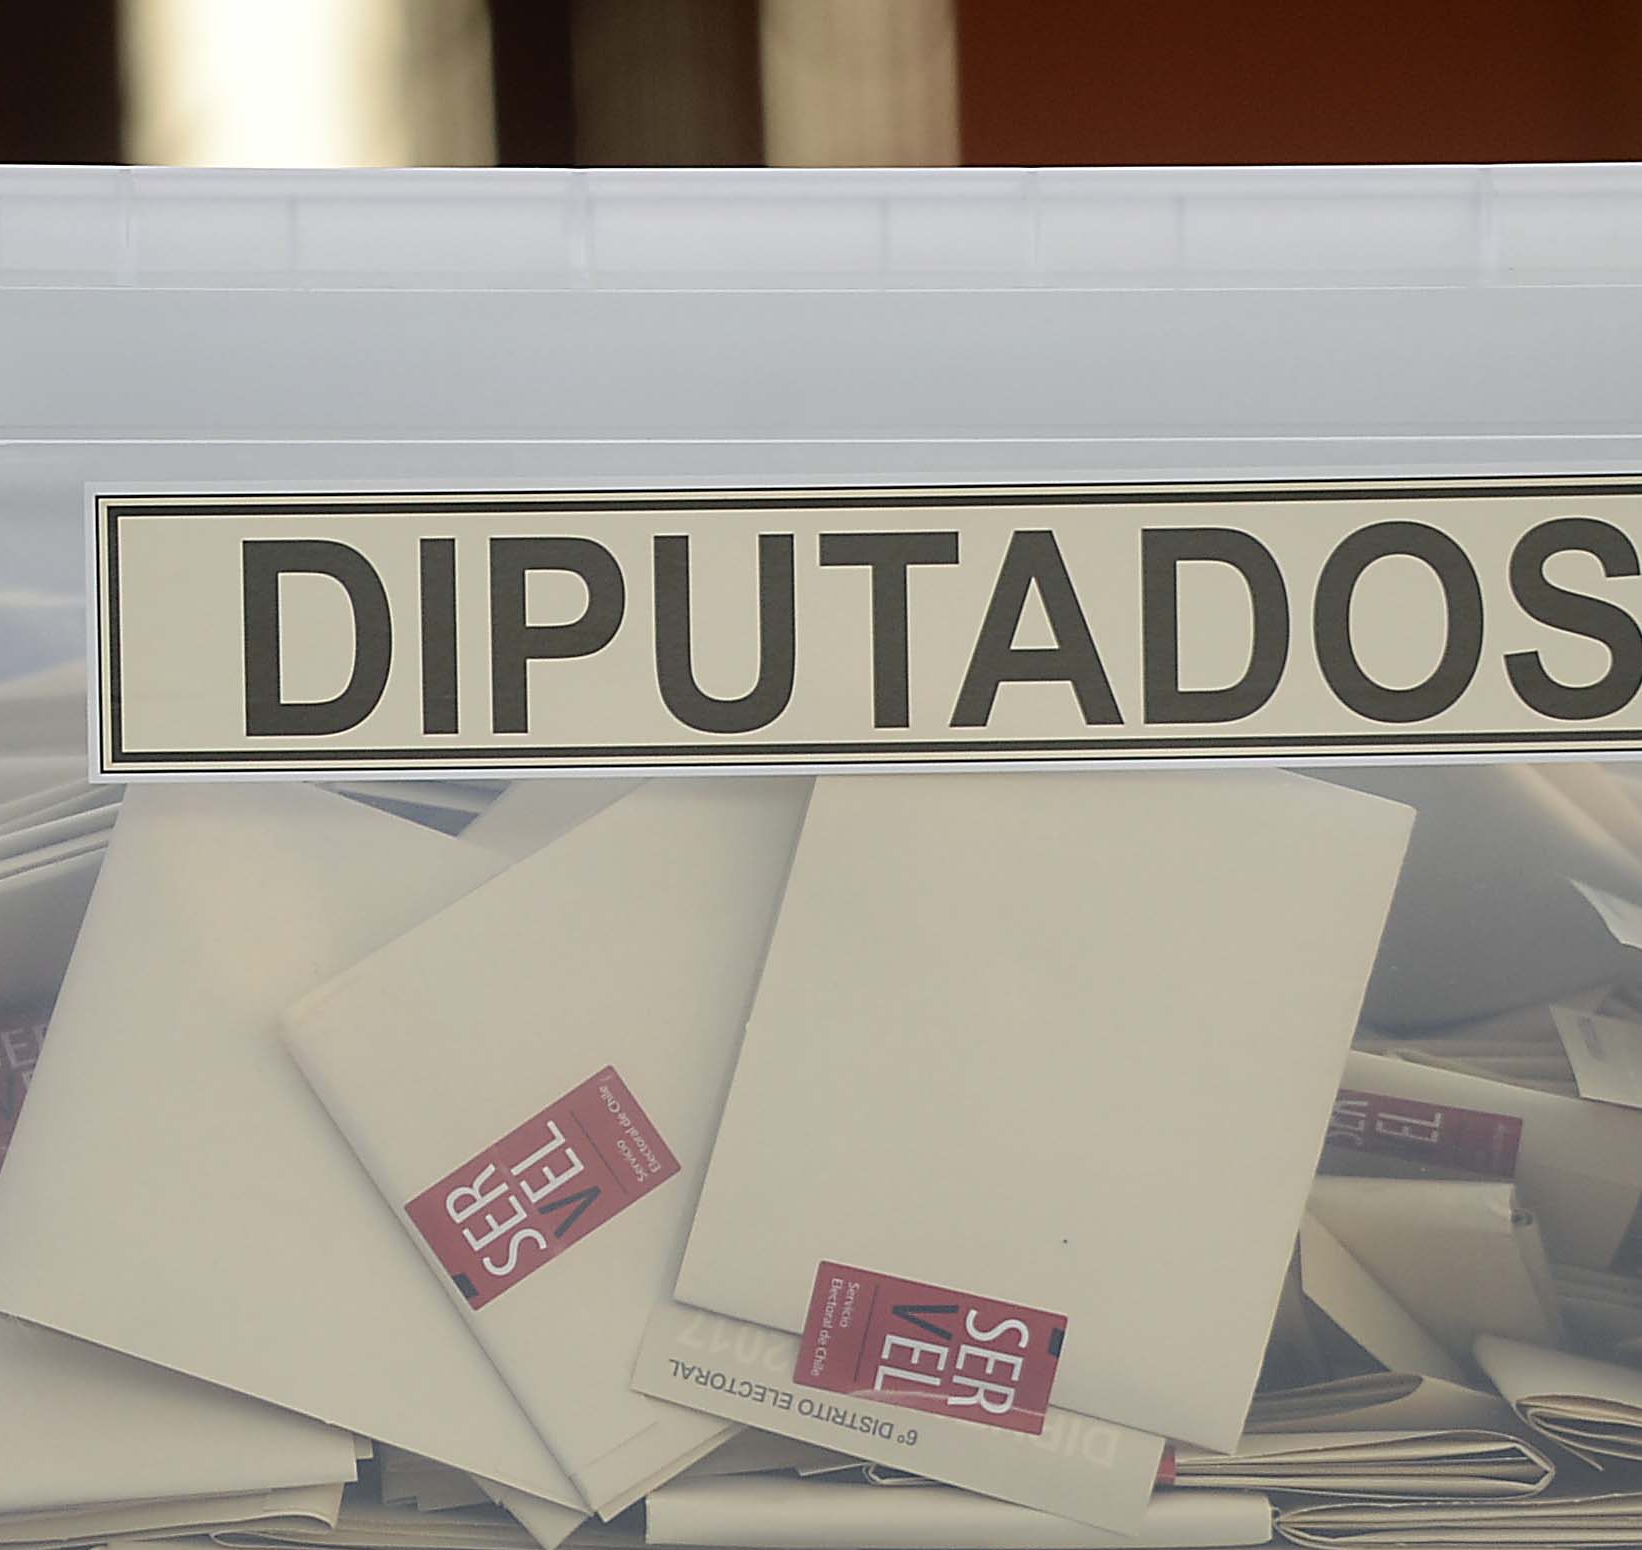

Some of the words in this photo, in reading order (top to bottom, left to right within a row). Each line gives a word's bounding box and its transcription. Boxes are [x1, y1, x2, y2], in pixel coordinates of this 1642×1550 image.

[599, 1085, 620, 1113] Chile
[618, 1112, 631, 1127] de
[617, 1140, 648, 1182] Servicio
[625, 1126, 661, 1173] Electoral
[510, 1120, 602, 1238] VEL
[445, 1164, 548, 1277] SER
[823, 1278, 843, 1329] Electoral
[839, 1282, 860, 1328] Servicio
[817, 1329, 831, 1345] de
[873, 1303, 959, 1392] VEL
[669, 1358, 795, 1410] ELECTORAL
[811, 1347, 827, 1376] Chile
[948, 1308, 1032, 1415] SER
[798, 1398, 895, 1440] DISTRITO
